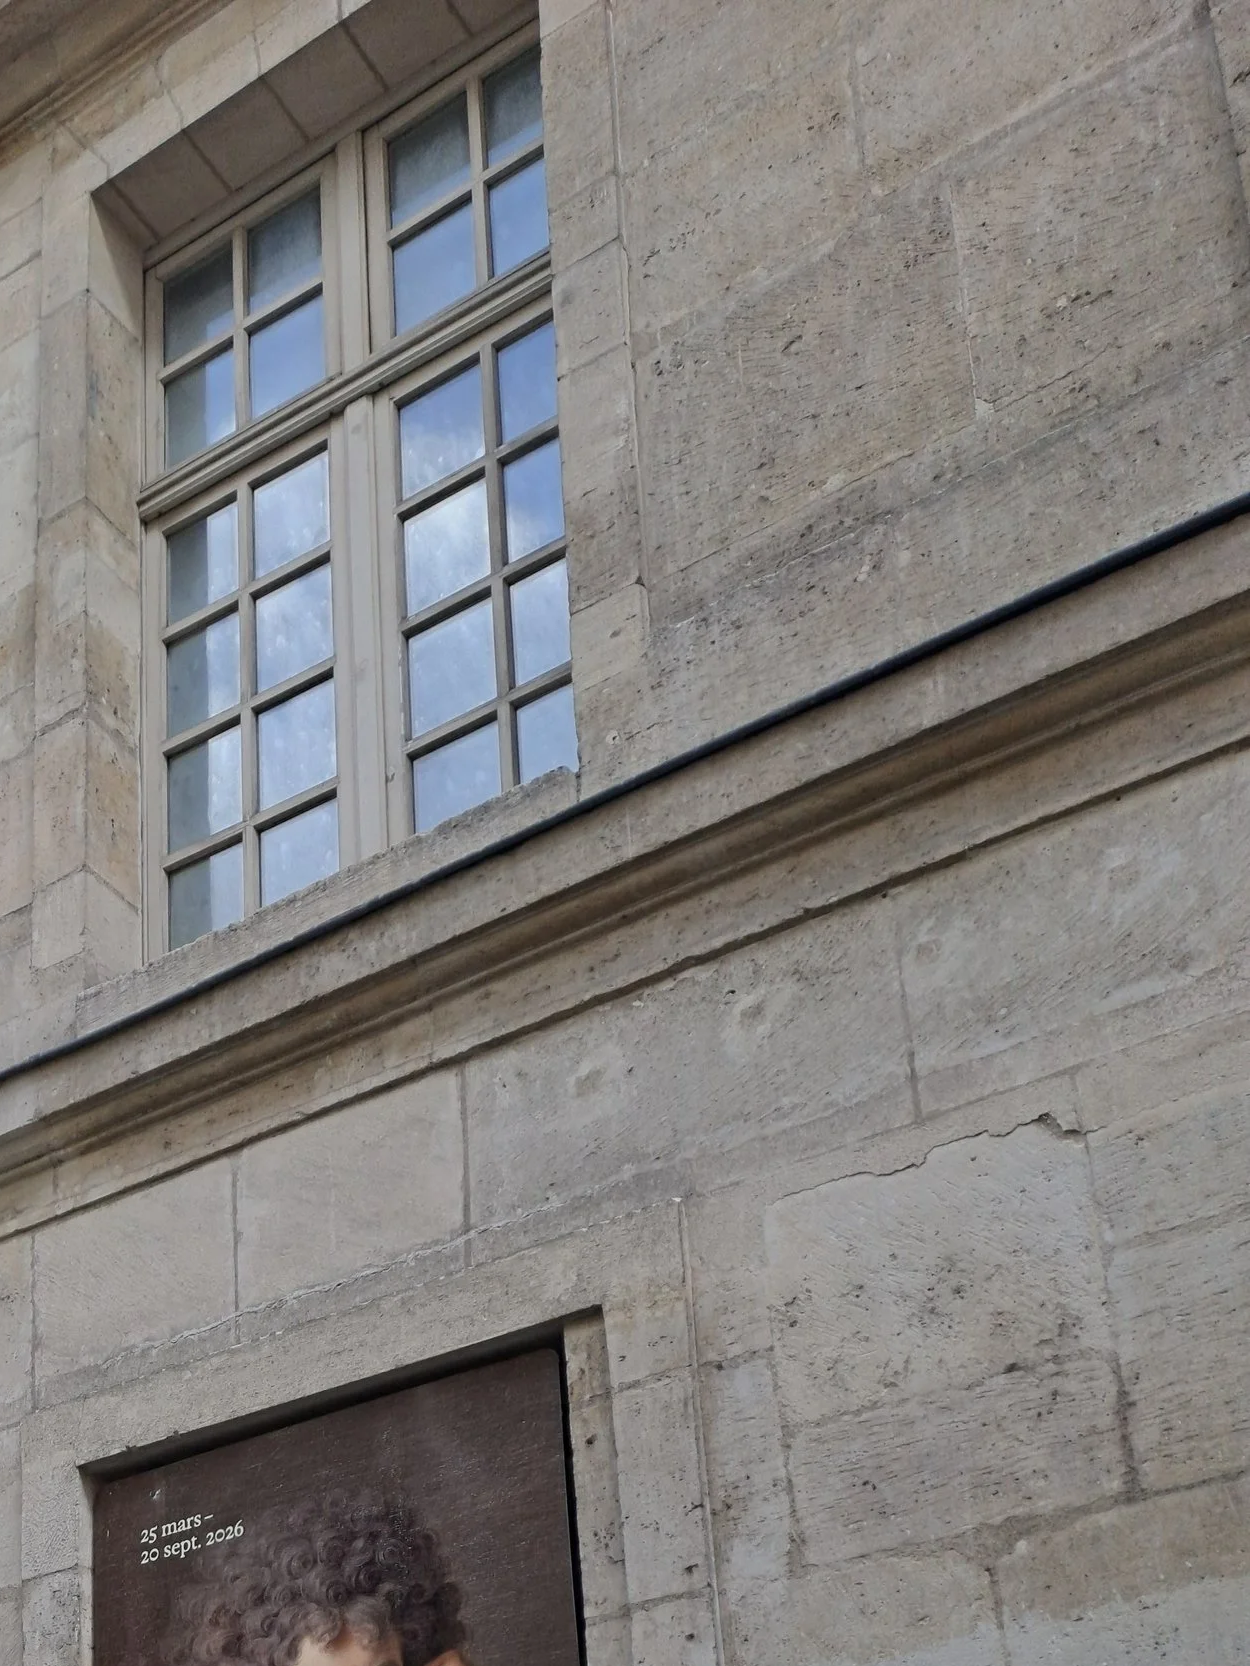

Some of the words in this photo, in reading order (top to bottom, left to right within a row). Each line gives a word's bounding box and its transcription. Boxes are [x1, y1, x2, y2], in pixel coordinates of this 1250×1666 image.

[140, 1525, 158, 1544] 25
[161, 1513, 202, 1538] mars
[140, 1548, 160, 1565] 20
[164, 1535, 202, 1559] sept.
[206, 1520, 244, 1547] 2026
